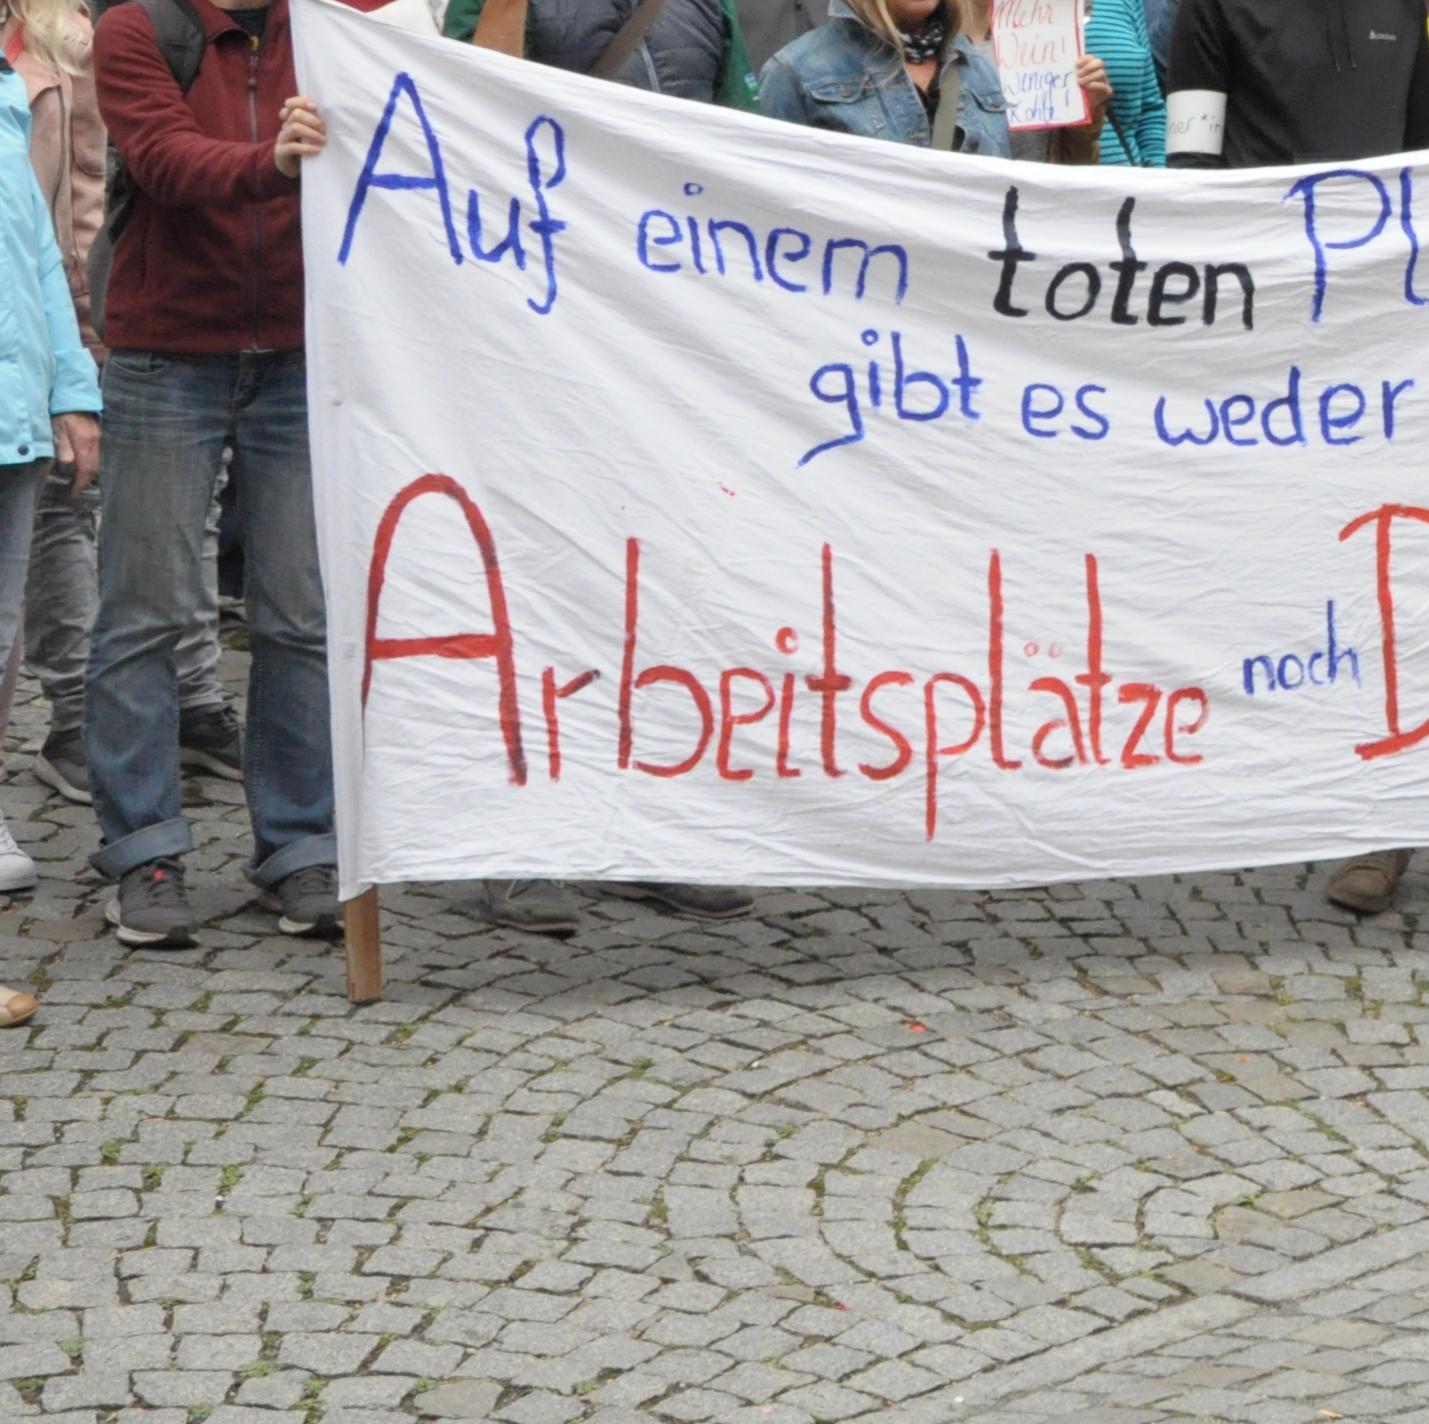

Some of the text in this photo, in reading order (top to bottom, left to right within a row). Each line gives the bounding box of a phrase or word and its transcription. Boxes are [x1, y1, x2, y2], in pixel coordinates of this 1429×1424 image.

[1004, 70, 1074, 97] Weniger
[337, 71, 567, 315] Auf
[637, 181, 909, 306] einem
[987, 184, 1255, 331] toten
[796, 328, 1415, 469] gibt es weder
[362, 473, 1210, 842] Arbeitsplätze
[1241, 598, 1362, 695] noch
